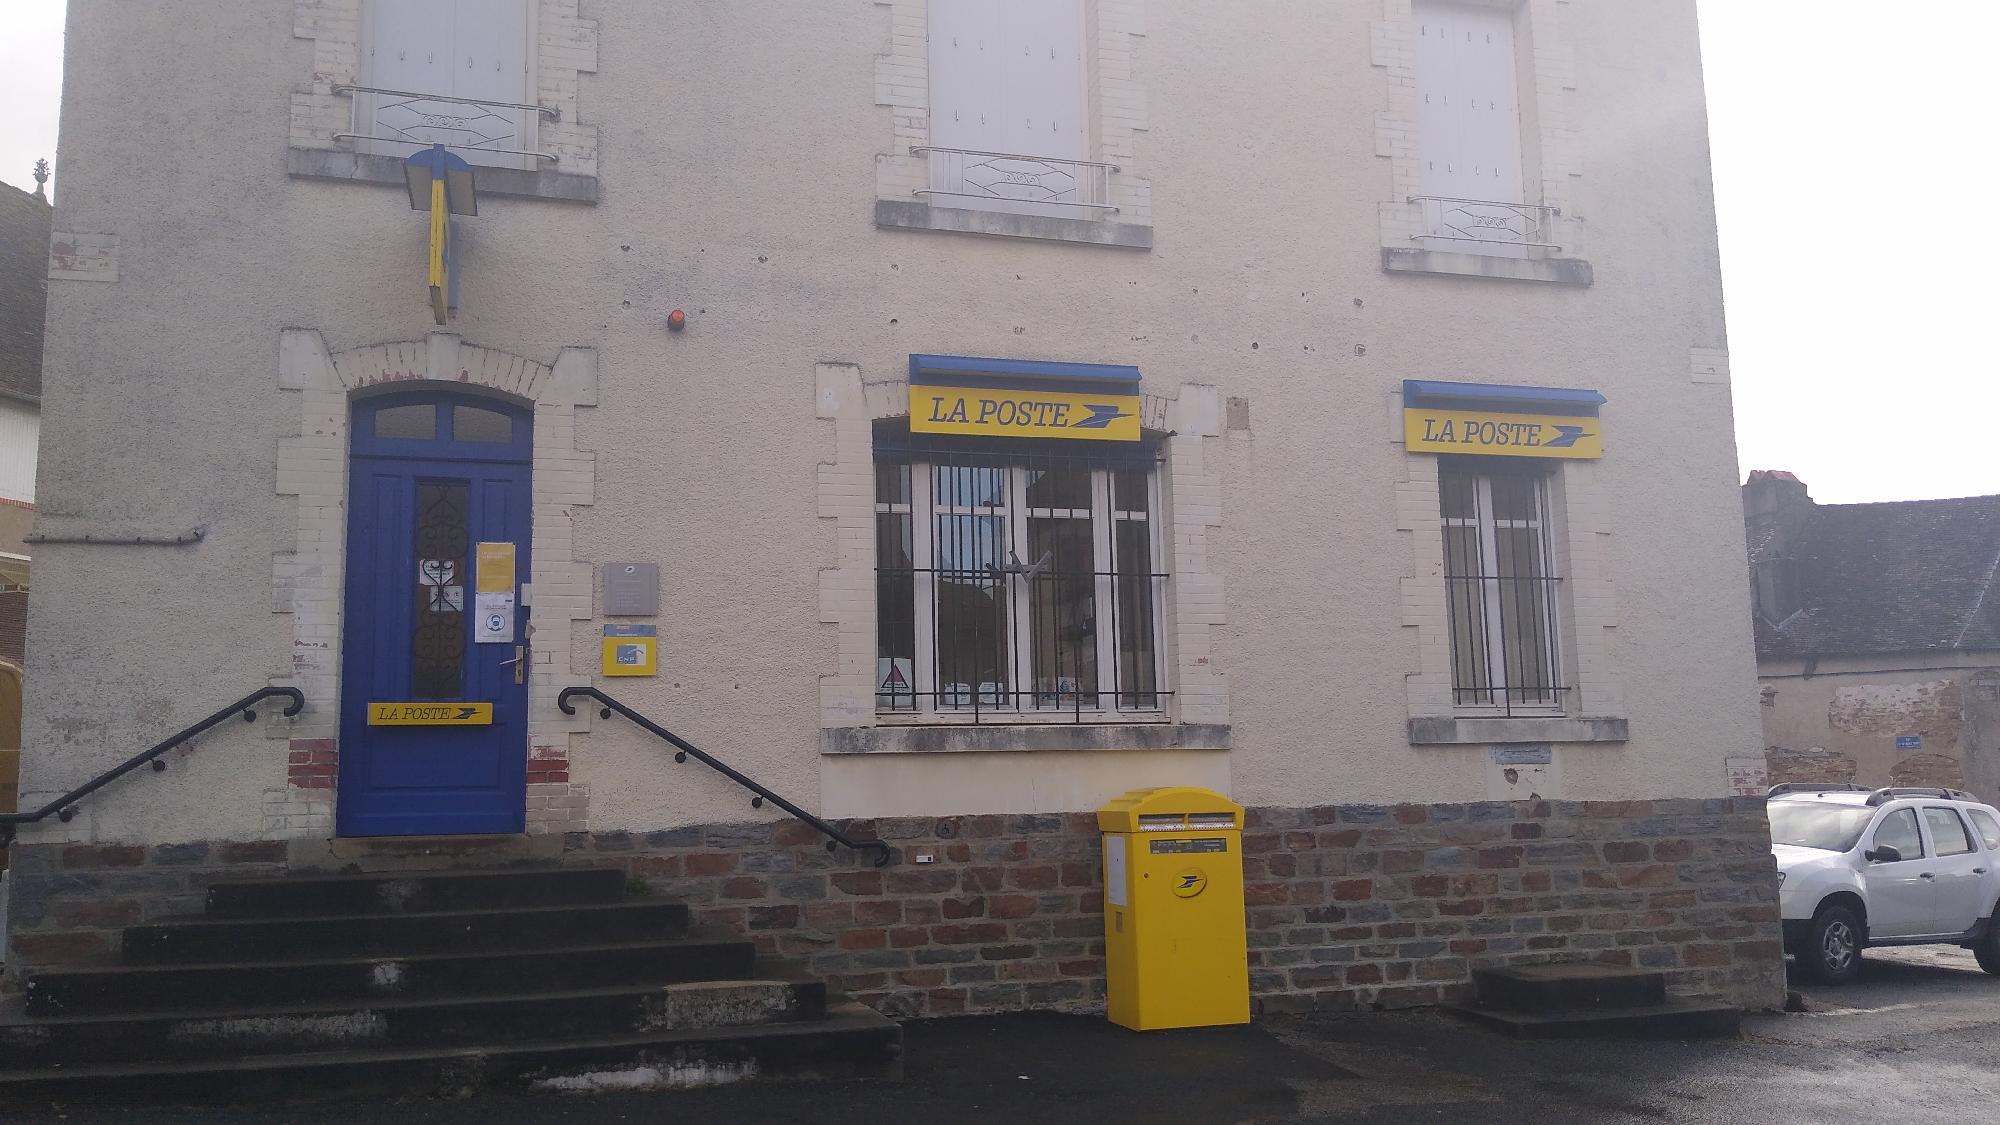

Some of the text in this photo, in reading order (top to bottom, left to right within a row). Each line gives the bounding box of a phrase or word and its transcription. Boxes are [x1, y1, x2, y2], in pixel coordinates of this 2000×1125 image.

[928, 397, 1070, 427] LA POSTE
[1422, 418, 1542, 447] LA POSTE
[378, 707, 451, 720] LA POSTE
